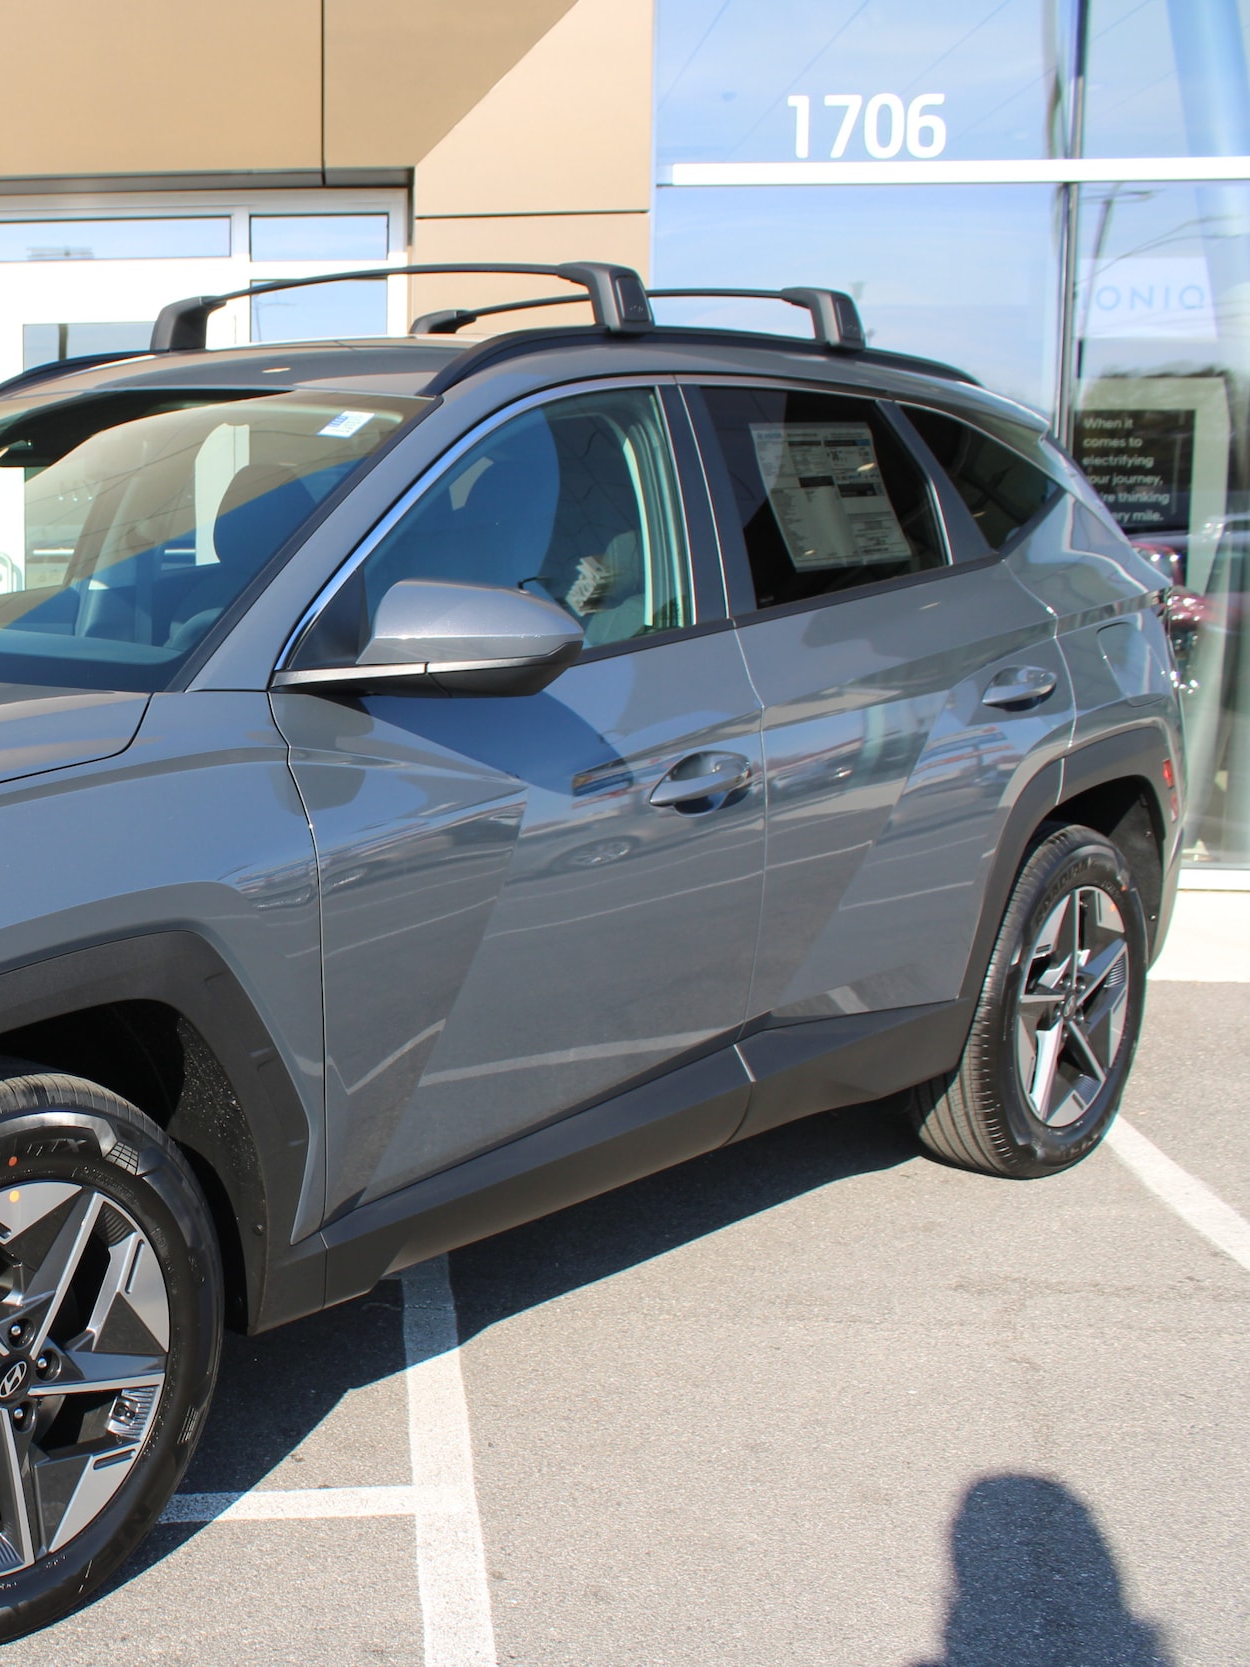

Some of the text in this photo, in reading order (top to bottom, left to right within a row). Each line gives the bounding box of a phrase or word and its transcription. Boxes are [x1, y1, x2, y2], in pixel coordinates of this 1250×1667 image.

[787, 92, 947, 160] 1706
[1083, 417, 1134, 429] When it
[1082, 437, 1143, 449] comes to
[1082, 454, 1154, 469] electrifying
[1112, 472, 1164, 486] journey,
[1118, 491, 1170, 506] thinking
[1133, 509, 1164, 522] mile.
